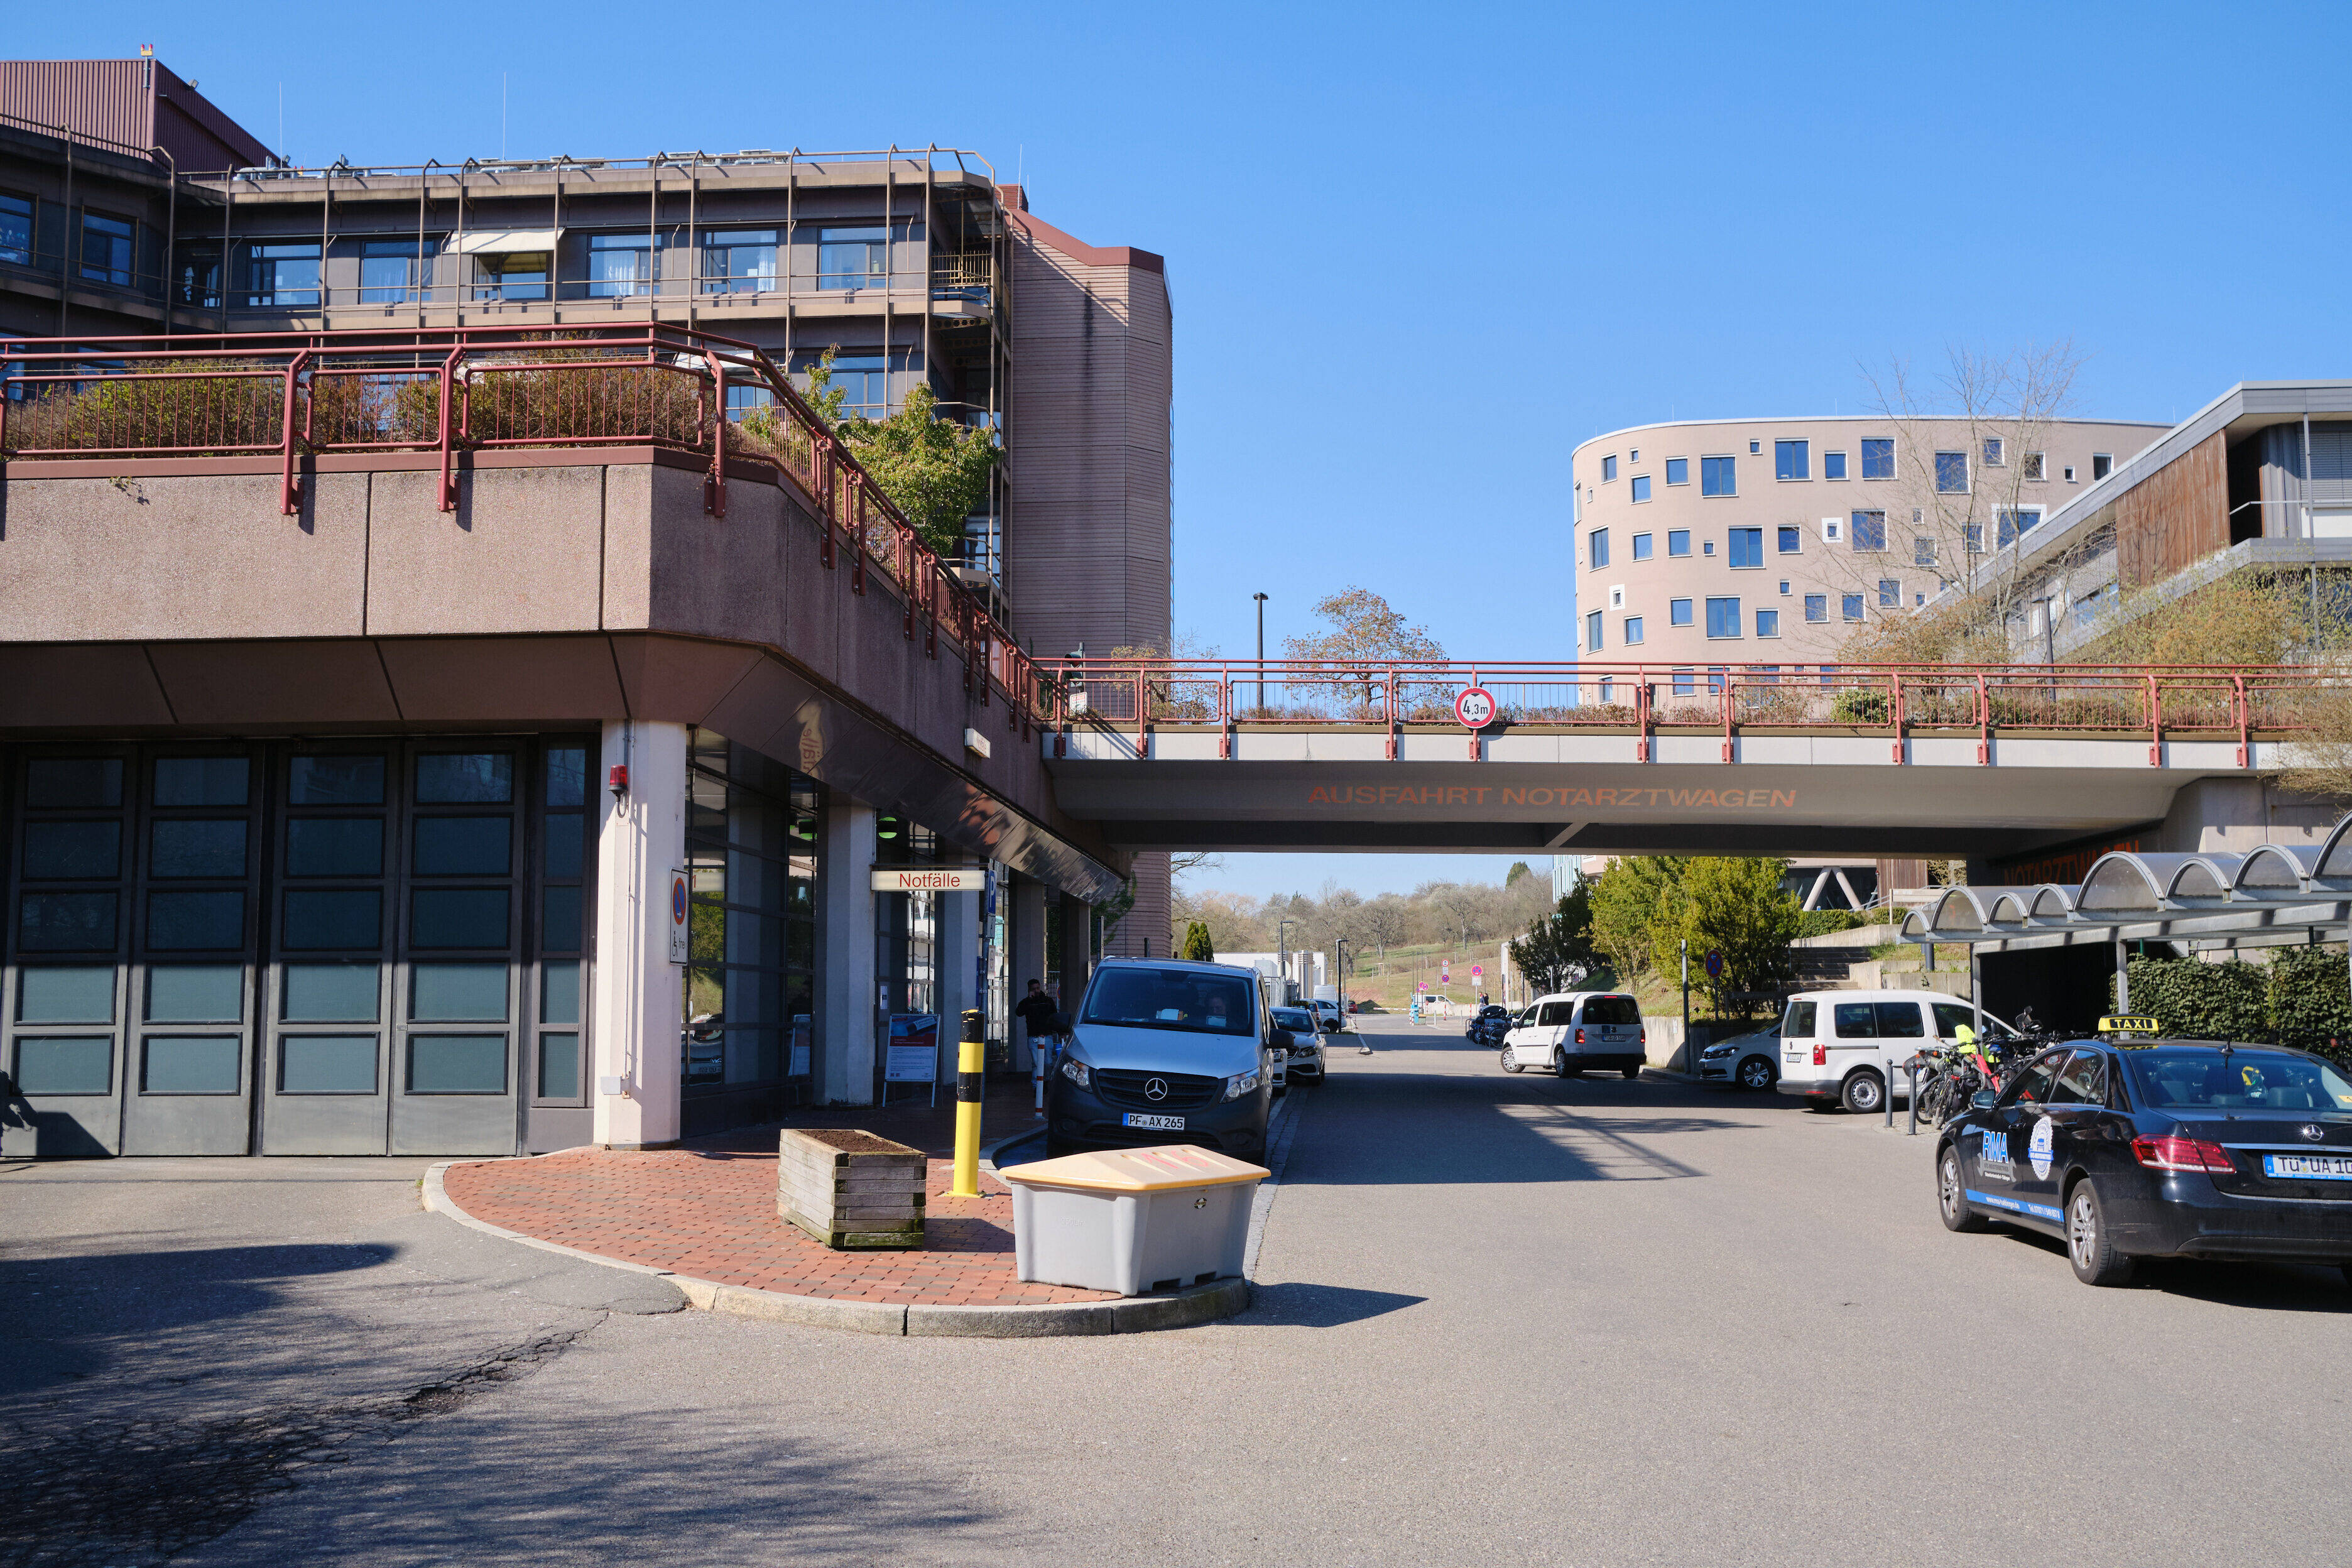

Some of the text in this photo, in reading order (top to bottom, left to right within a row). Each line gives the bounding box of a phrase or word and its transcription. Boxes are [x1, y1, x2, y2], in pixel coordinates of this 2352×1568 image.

[1308, 786, 1797, 807] AUSFAHRT NOTARZTWAGEN
[900, 873, 960, 887] Notfälle
[990, 876, 994, 908] P
[2115, 1020, 2147, 1028] TAXI
[1129, 1114, 1184, 1128] PF AX 265
[1983, 1131, 2010, 1163] RMA
[2278, 1157, 2299, 1172] TÜ
[2309, 1158, 2331, 1173] UA
